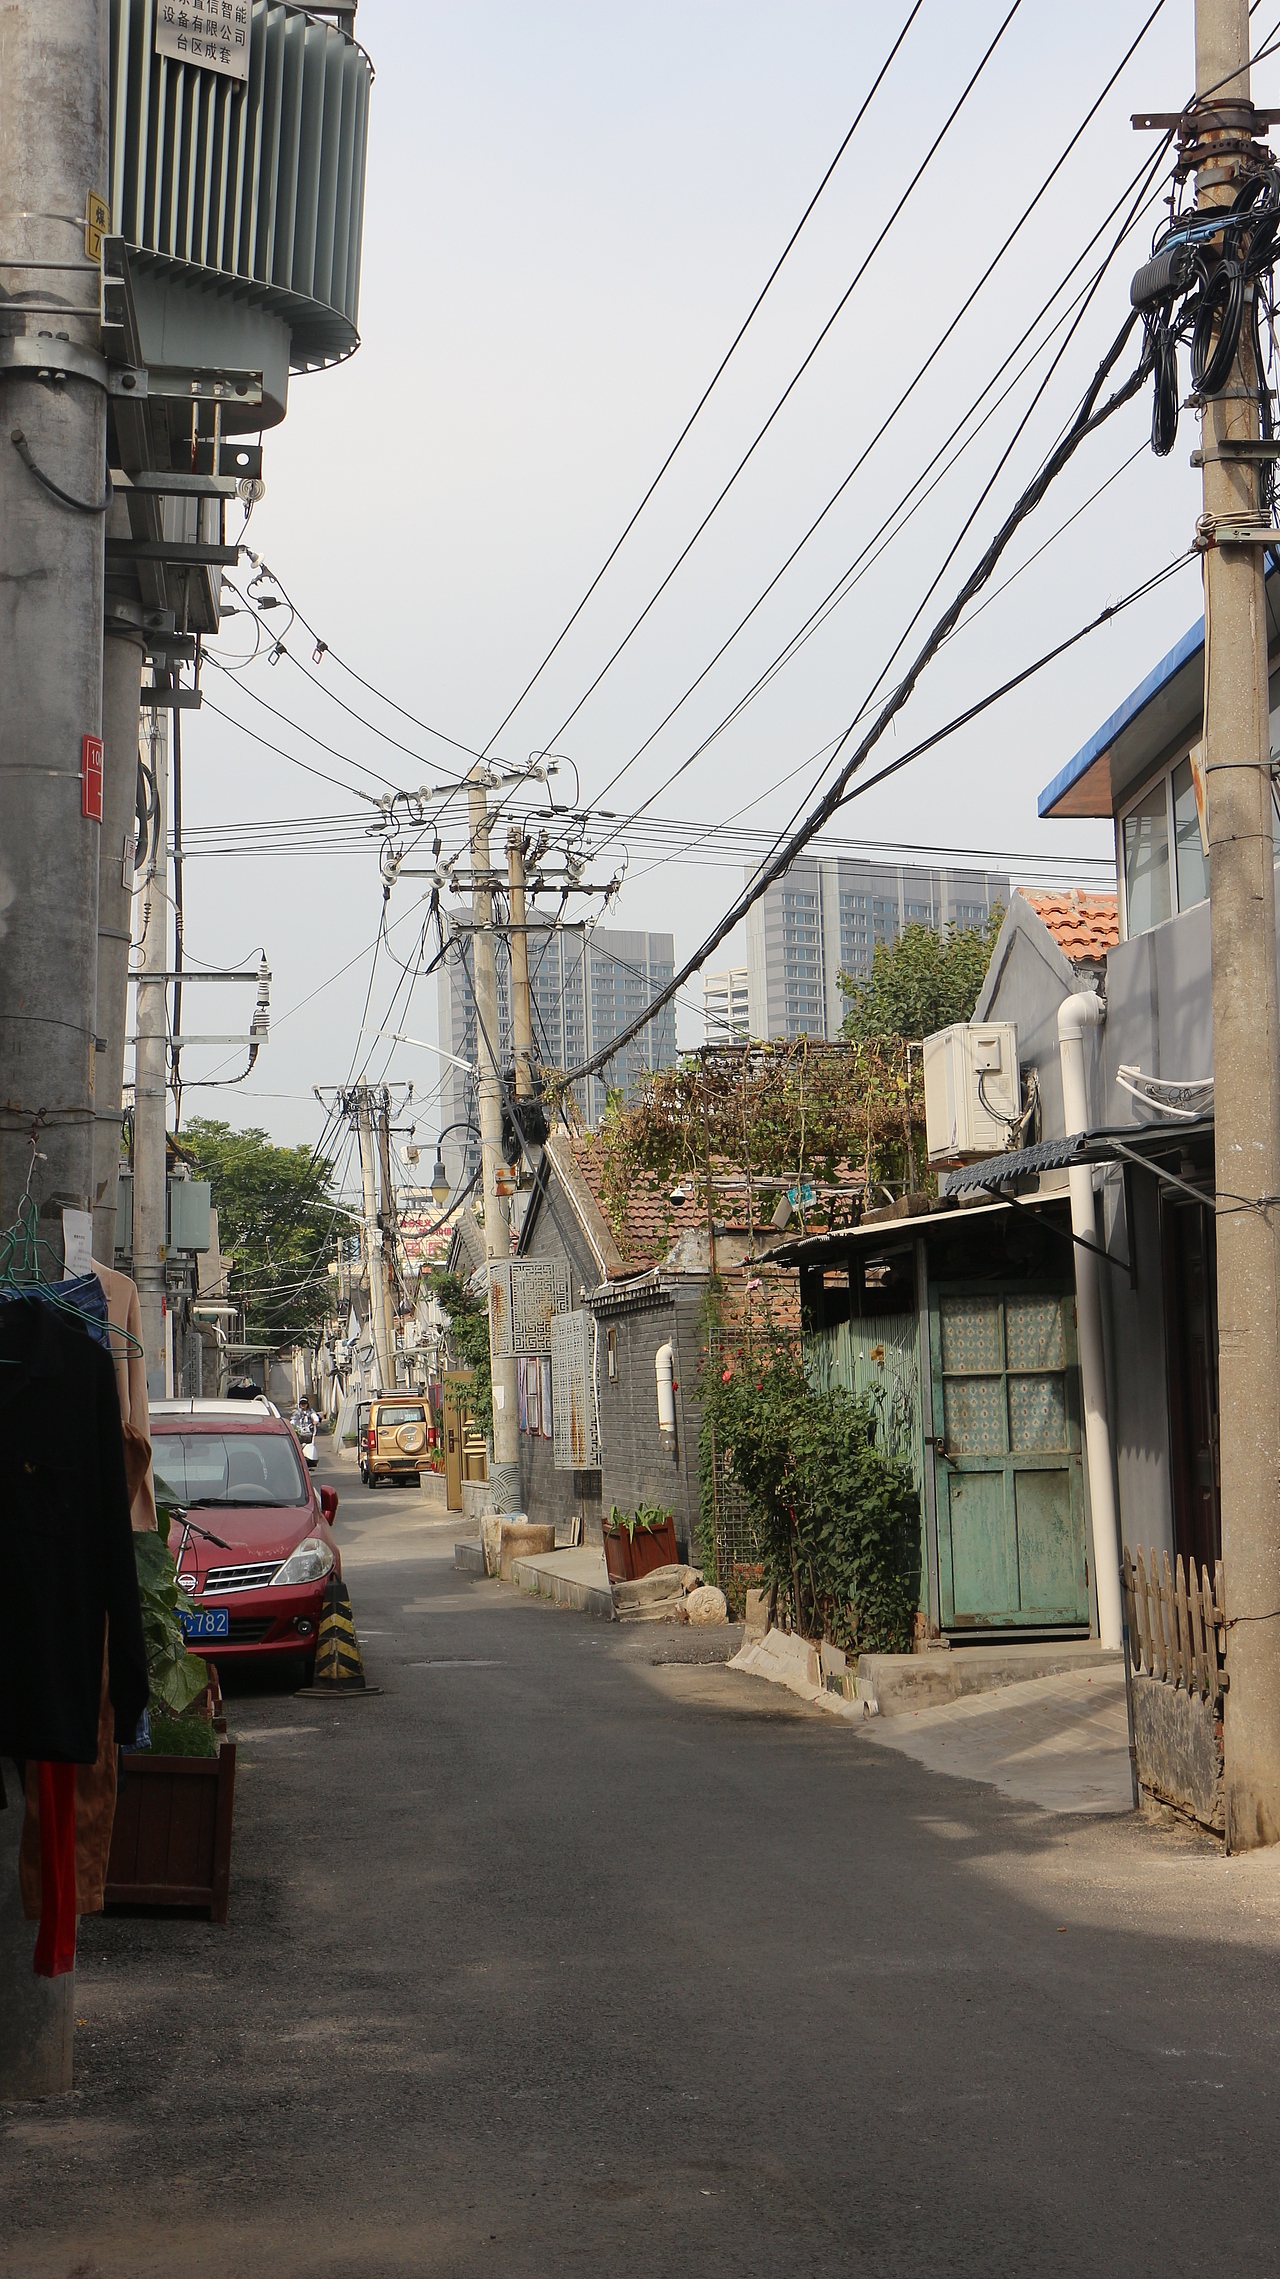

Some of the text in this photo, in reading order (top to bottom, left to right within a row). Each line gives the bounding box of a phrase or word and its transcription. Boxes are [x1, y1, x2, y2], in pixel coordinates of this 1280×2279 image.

[163, 5, 245, 46] 设备有限公司
[172, 0, 246, 24] 直信智能
[177, 34, 231, 65] 台区成套
[179, 1613, 226, 1632] C782
